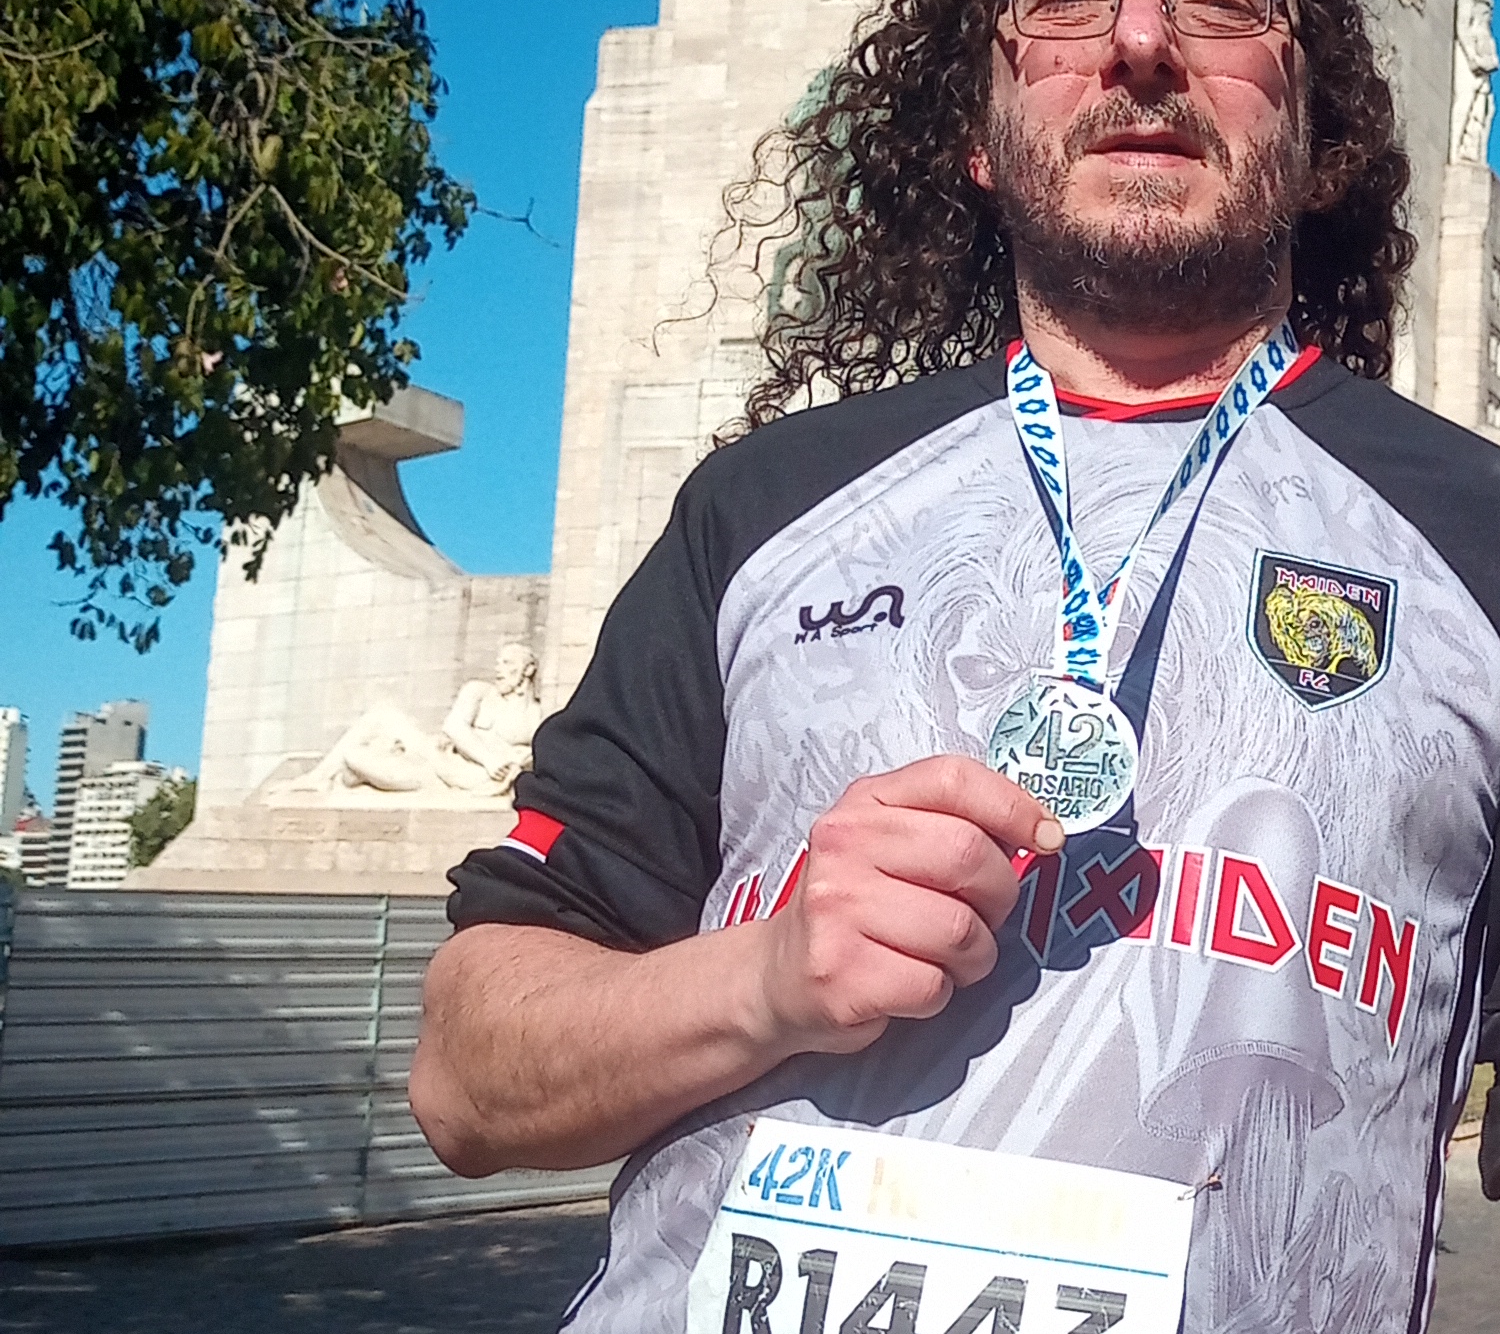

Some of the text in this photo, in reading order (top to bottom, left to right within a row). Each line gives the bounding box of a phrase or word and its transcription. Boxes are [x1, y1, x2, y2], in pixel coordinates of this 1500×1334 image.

[1275, 566, 1381, 613] MAIDEN
[1299, 669, 1331, 692] FC
[1018, 771, 1105, 800] ROSARIO
[747, 1143, 852, 1212] 42K
